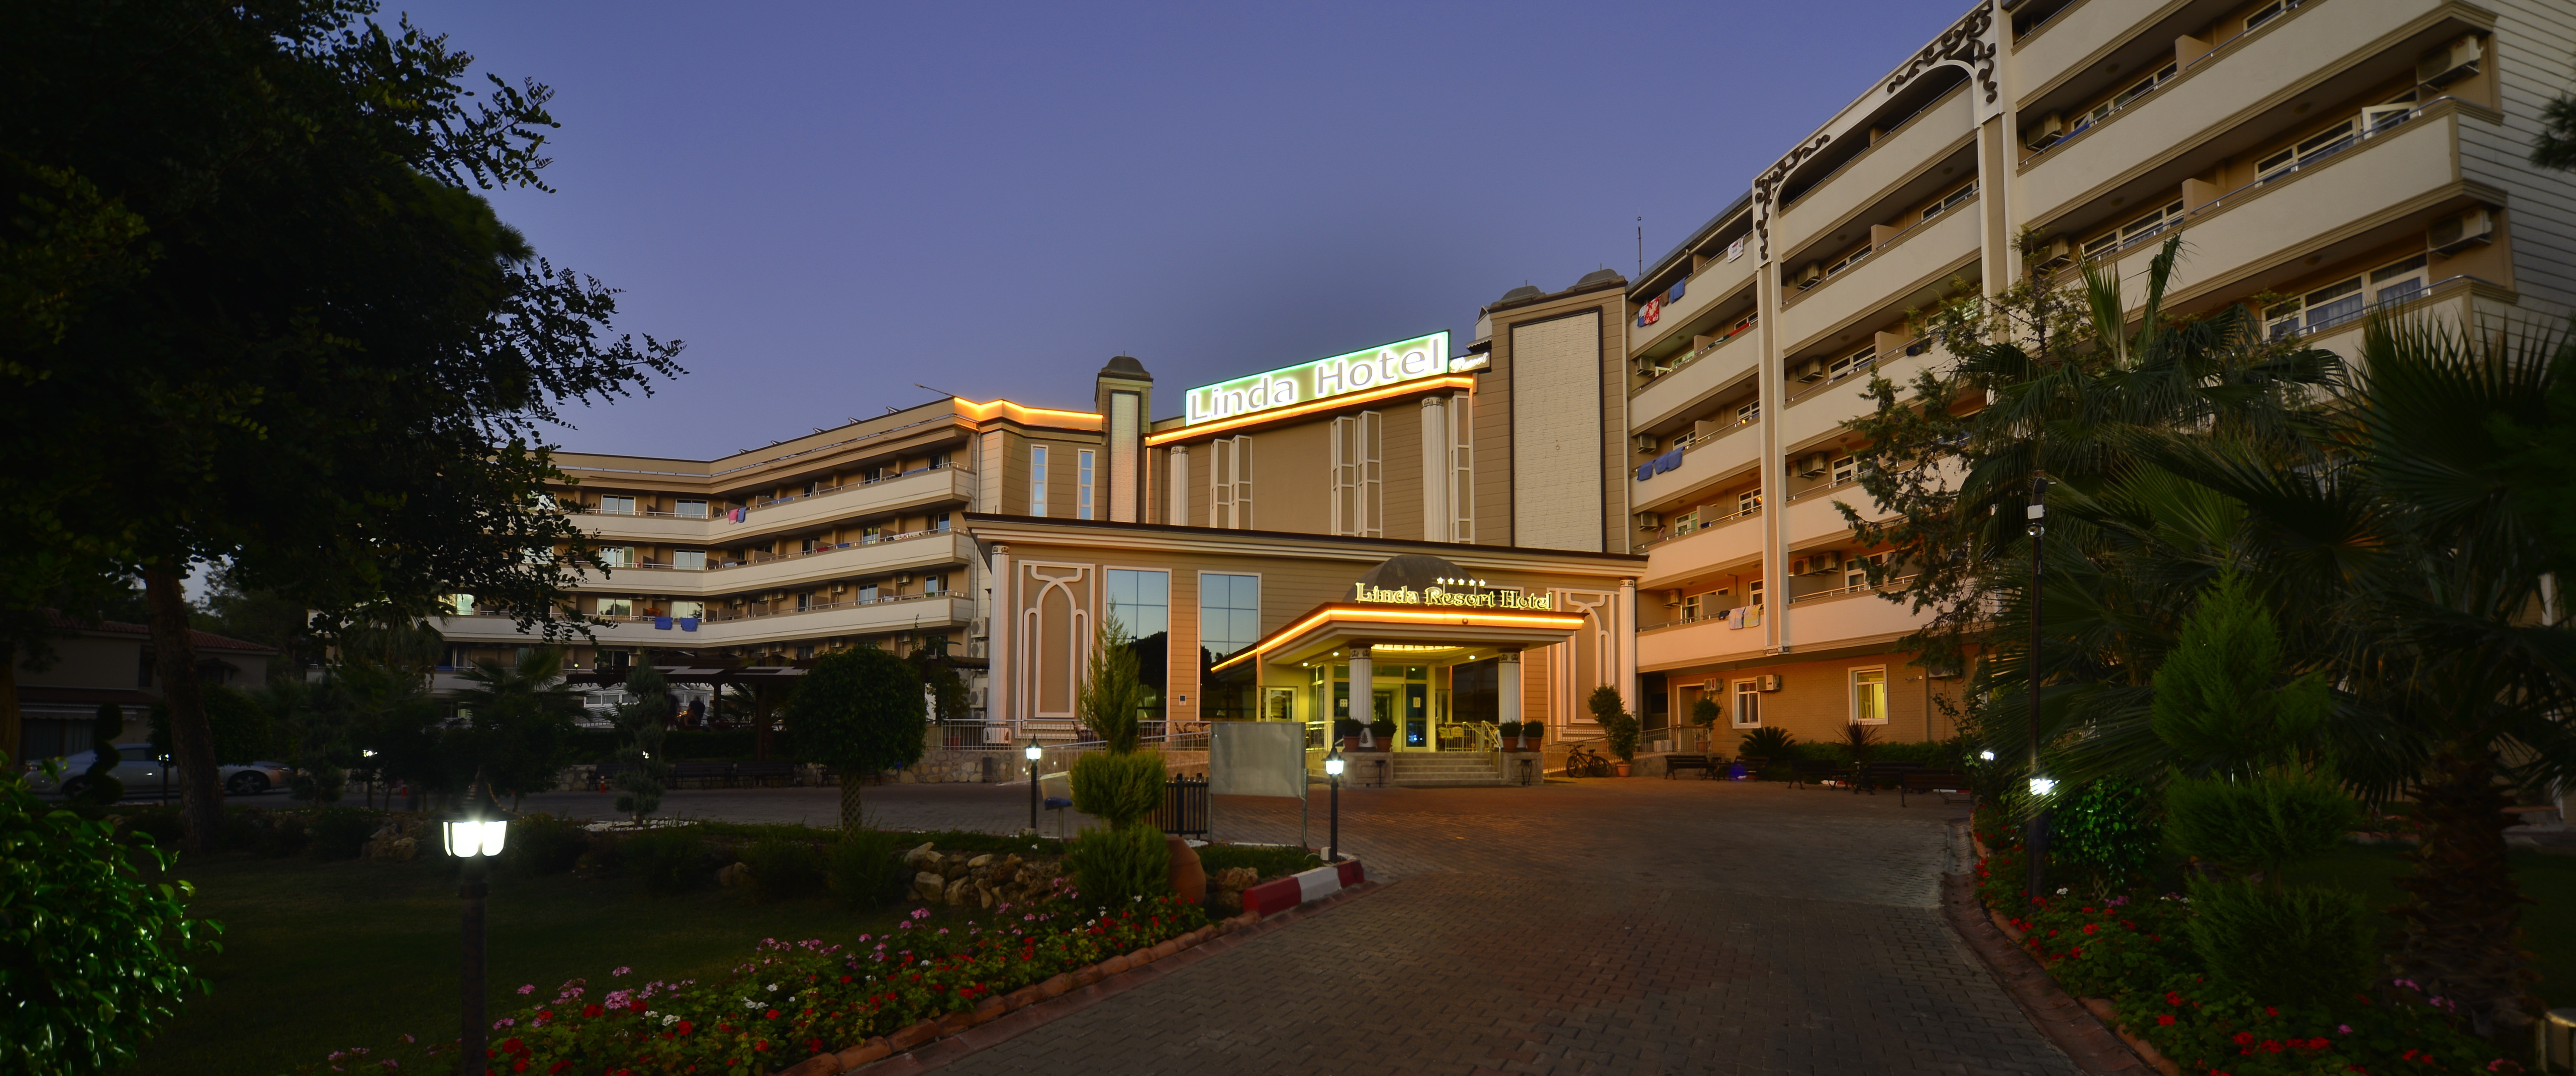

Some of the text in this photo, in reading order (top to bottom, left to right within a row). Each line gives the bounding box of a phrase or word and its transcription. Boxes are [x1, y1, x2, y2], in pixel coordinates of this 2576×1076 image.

[1191, 338, 1439, 421] Linda Hotel
[1355, 582, 1552, 610] Linda Resort Hotel
